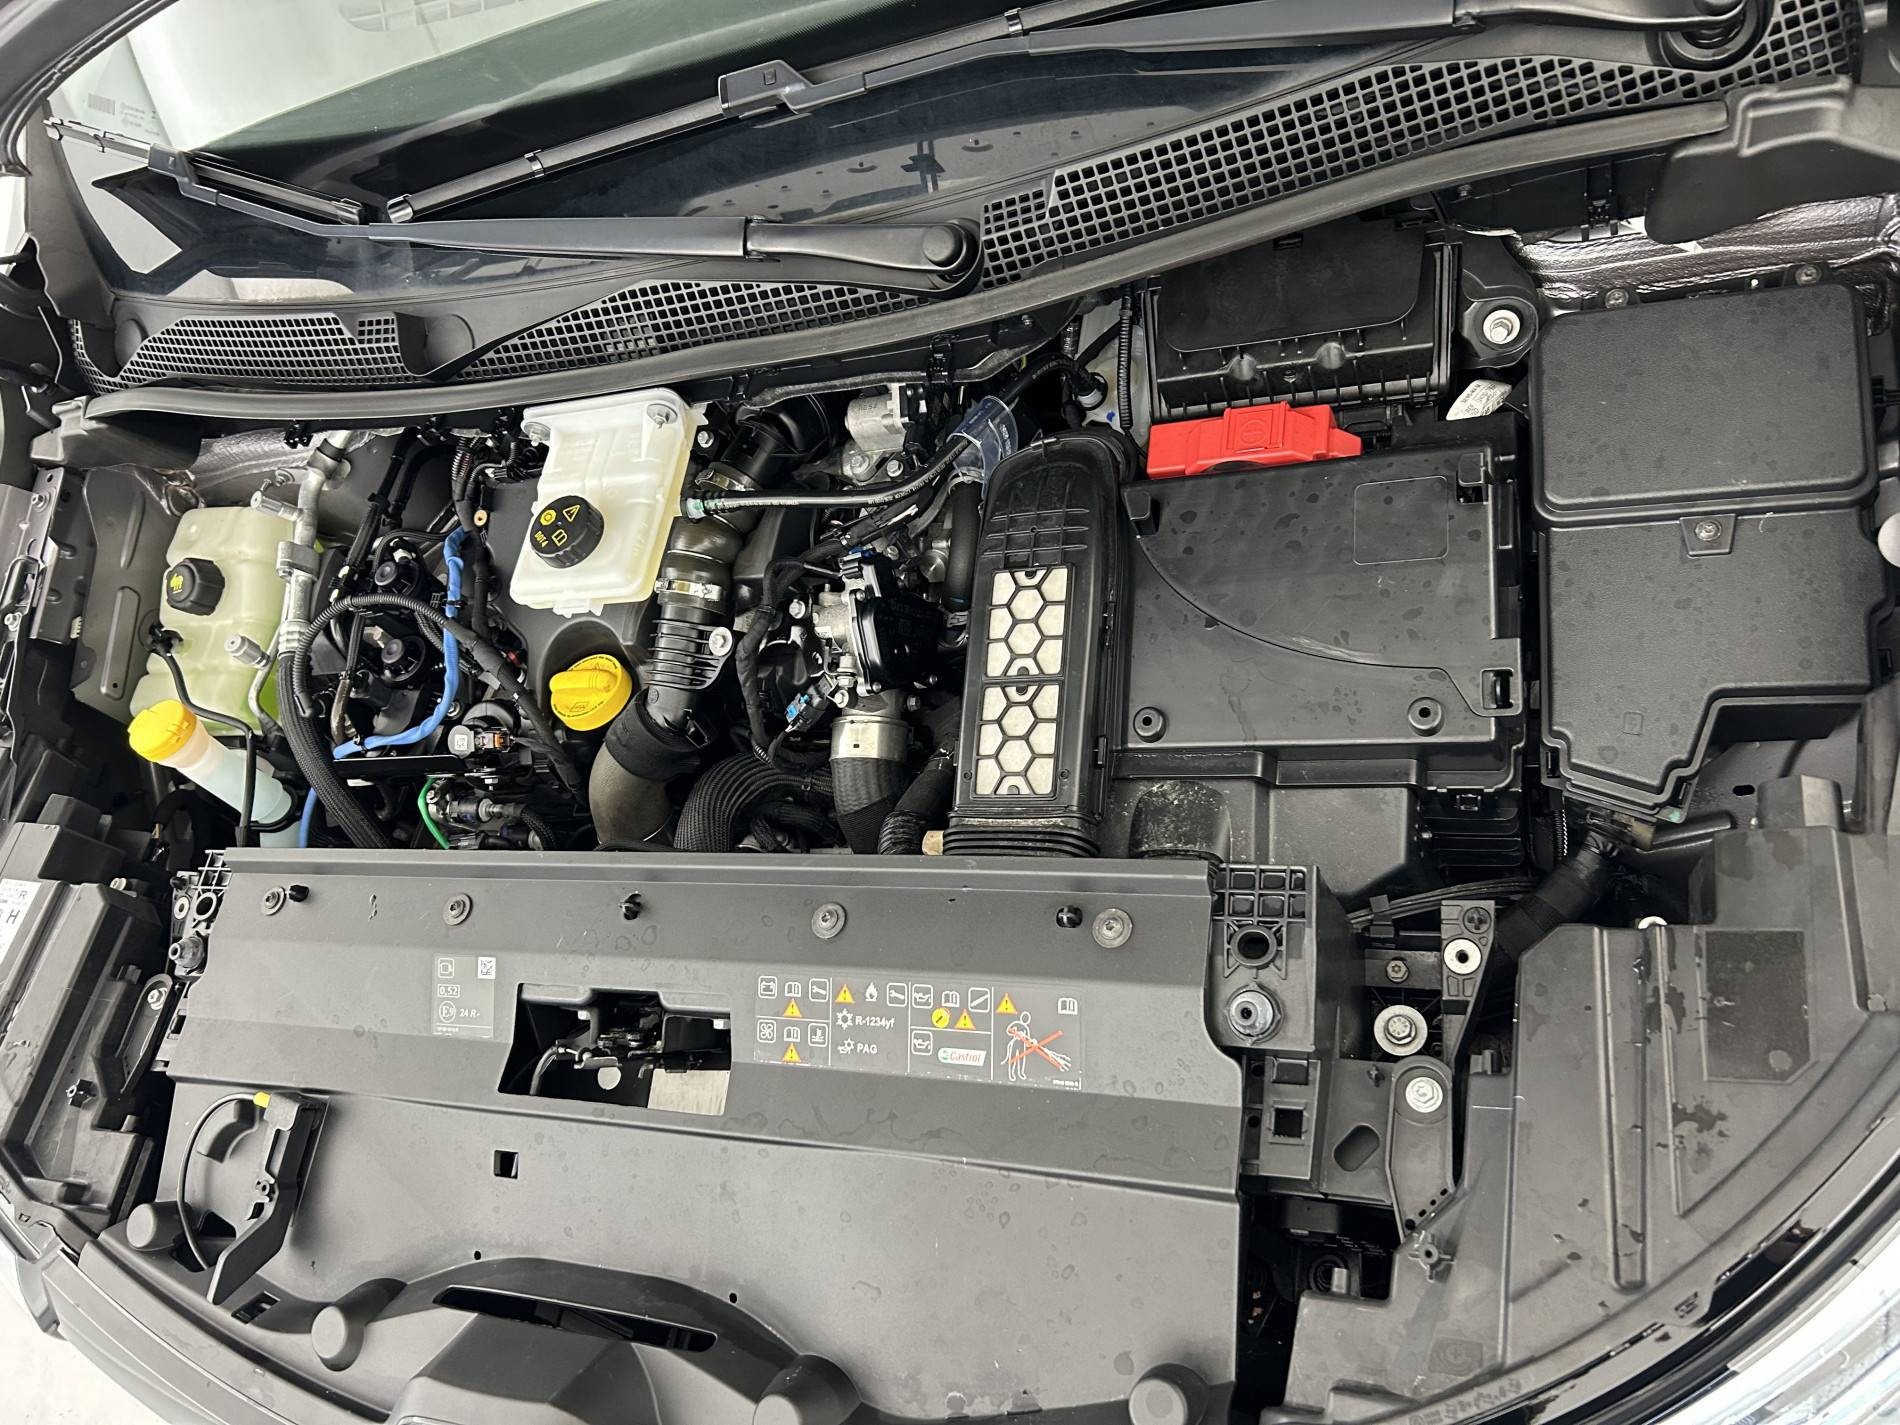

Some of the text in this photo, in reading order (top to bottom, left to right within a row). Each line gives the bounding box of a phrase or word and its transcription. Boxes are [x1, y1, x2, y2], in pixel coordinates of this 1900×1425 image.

[855, 1015, 895, 1030] R-1234yf
[856, 1043, 878, 1055] PAG
[949, 1051, 982, 1064] Castrol
